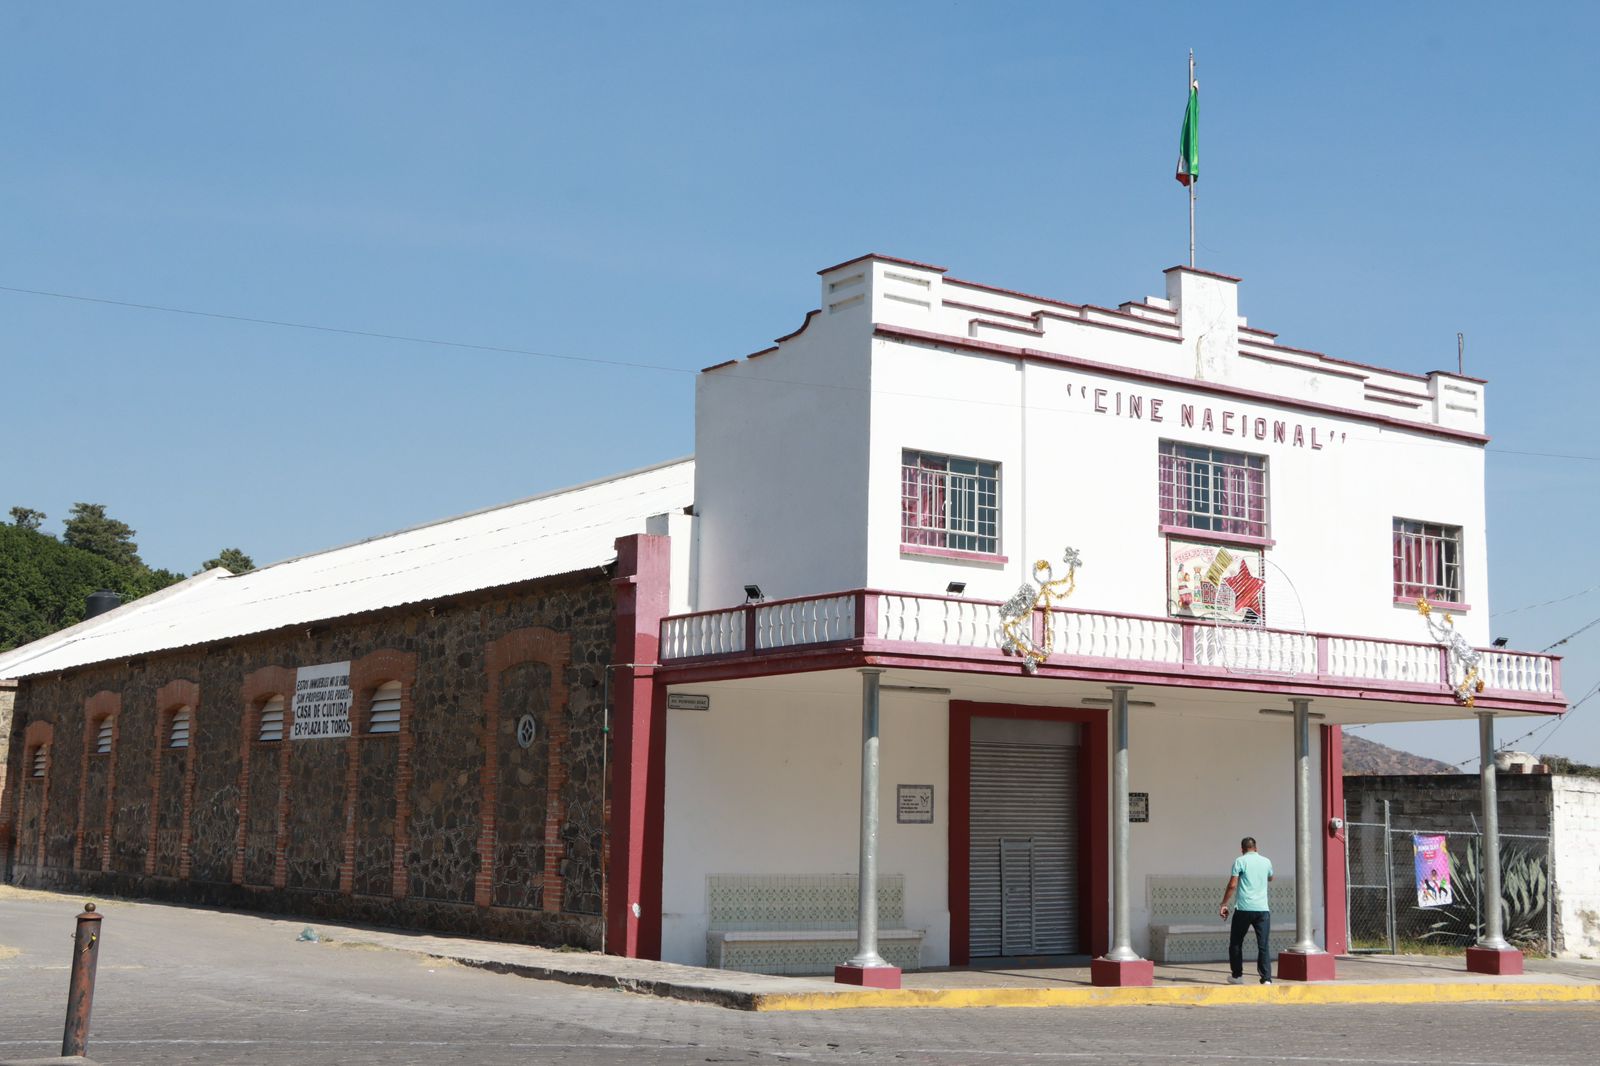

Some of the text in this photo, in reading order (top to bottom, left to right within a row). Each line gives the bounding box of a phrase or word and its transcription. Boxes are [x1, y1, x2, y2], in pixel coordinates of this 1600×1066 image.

[296, 702, 347, 719] CASA DE CULTURA
[295, 719, 351, 736] EX-PLAZA DE TOROS
